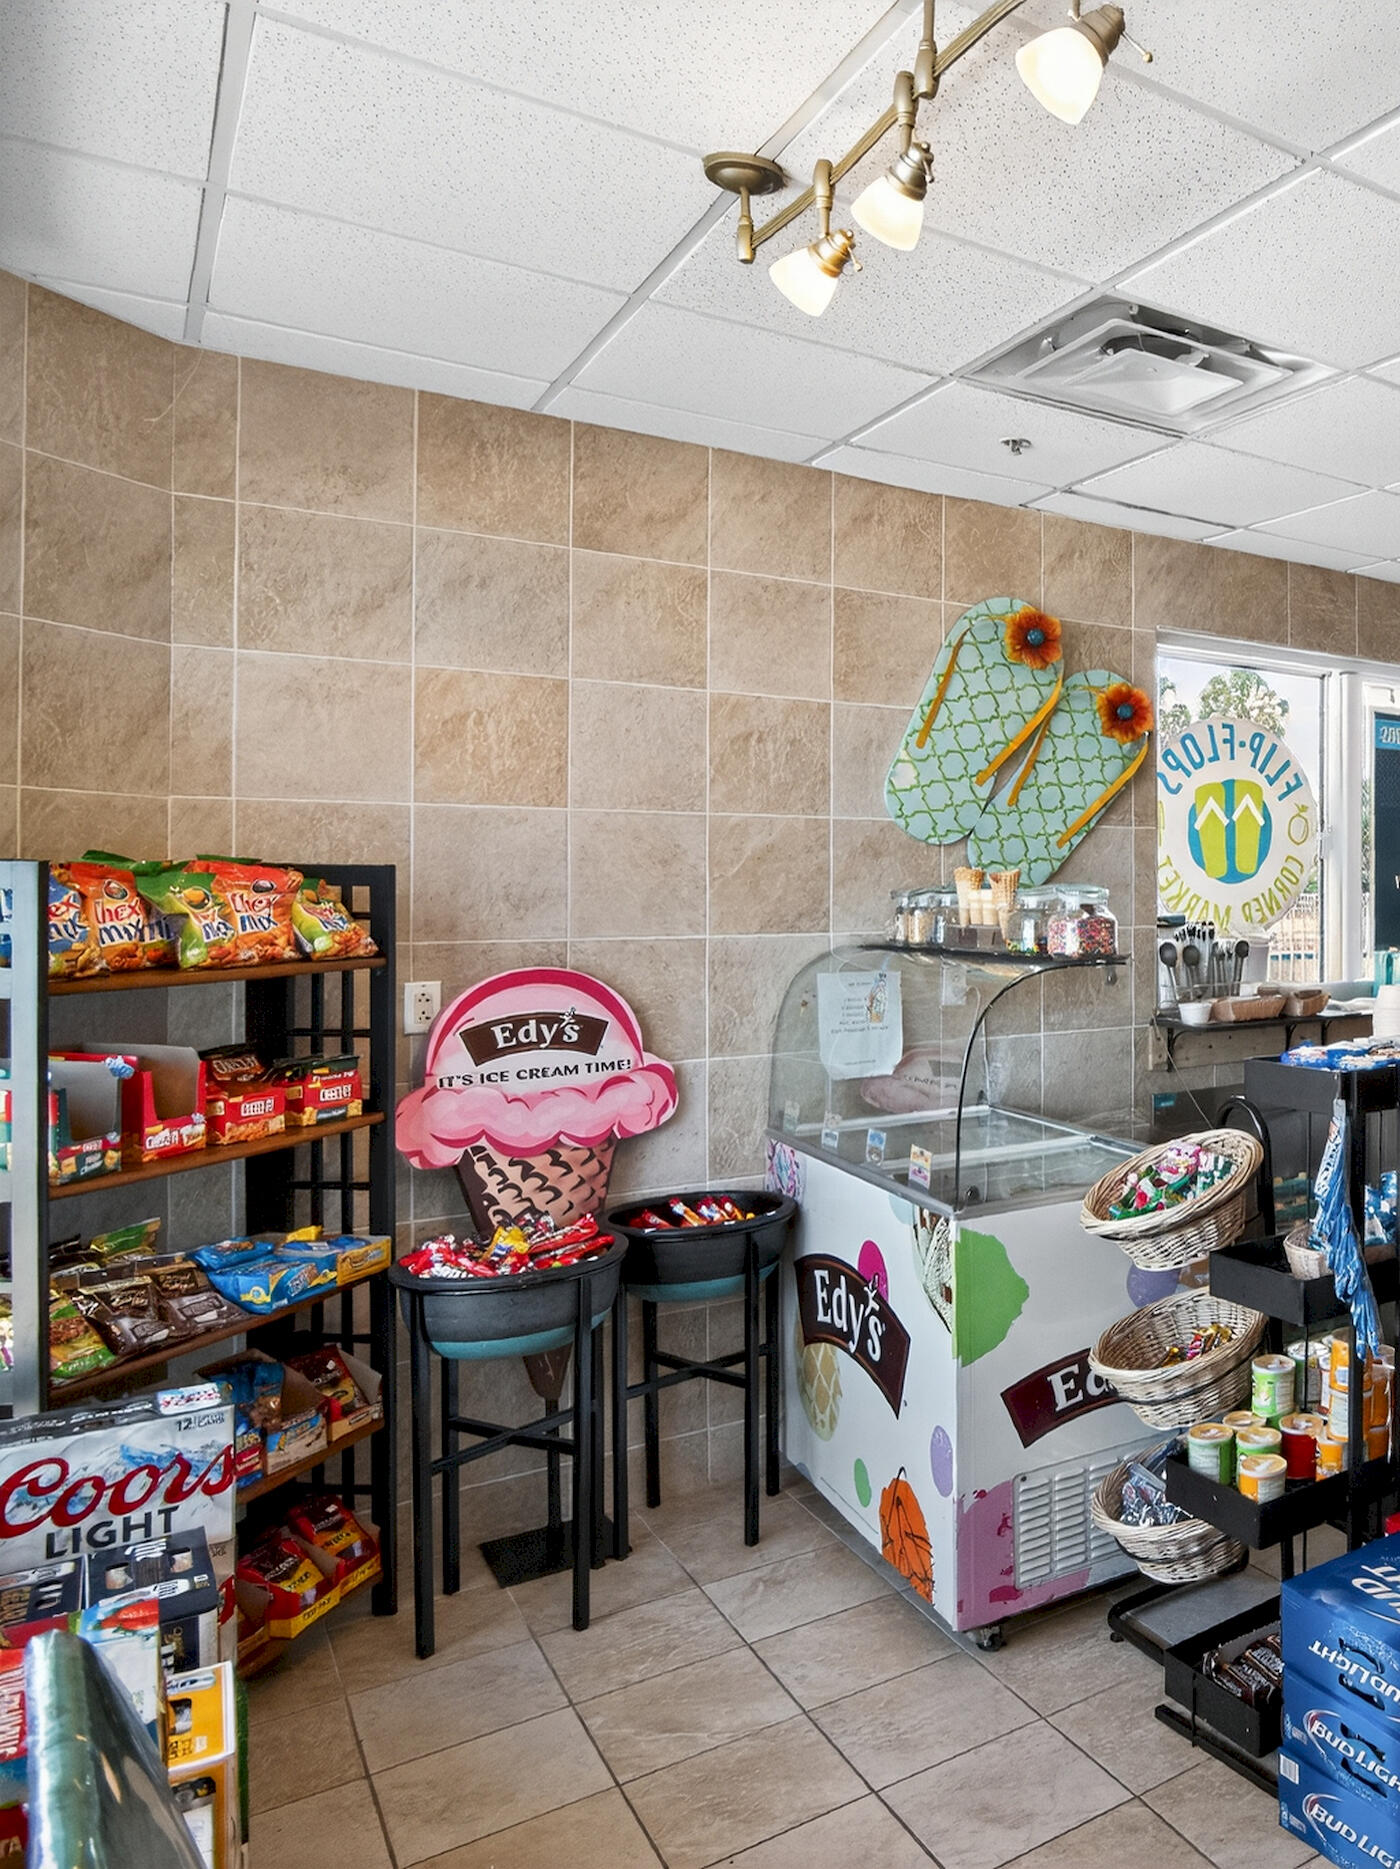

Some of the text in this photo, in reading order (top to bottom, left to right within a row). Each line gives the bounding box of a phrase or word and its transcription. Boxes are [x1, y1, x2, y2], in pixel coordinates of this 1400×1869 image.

[490, 1007, 582, 1049] Edy's
[438, 1058, 632, 1089] IT'S ICE CREAM TIME!
[814, 1269, 883, 1362] Edy's
[0, 1443, 237, 1539] Coors
[45, 1505, 179, 1559] LIGHT
[1308, 1640, 1370, 1686] LIGHT
[1311, 1719, 1355, 1758] BUD
[1311, 1803, 1357, 1843] BUD
